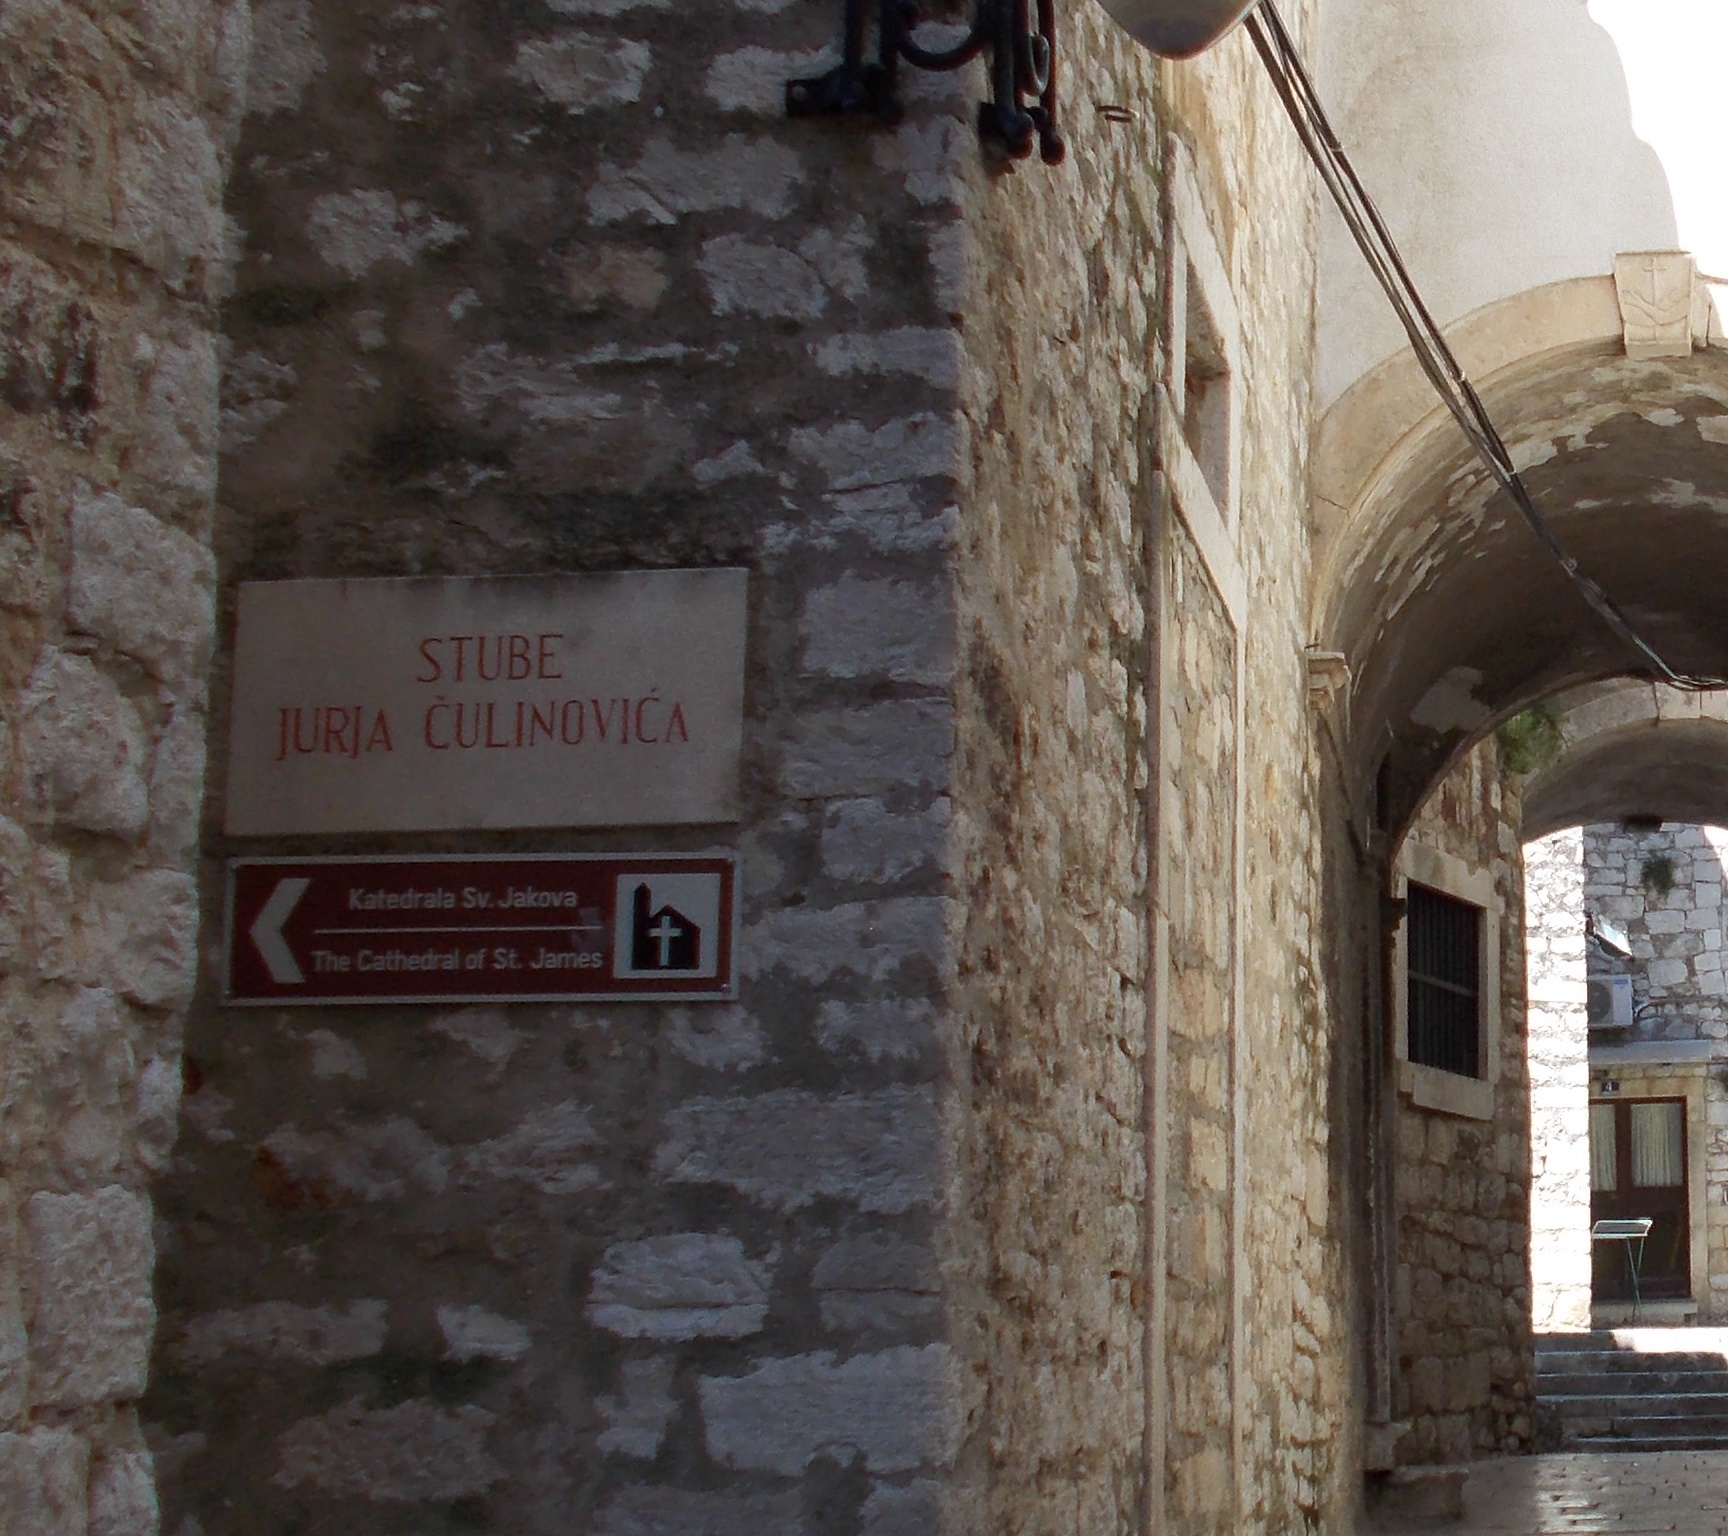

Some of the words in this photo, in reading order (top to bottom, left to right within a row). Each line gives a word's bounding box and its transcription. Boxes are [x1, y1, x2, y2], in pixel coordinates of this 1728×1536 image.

[416, 633, 565, 683] STUBE
[275, 705, 394, 762] JURJA
[423, 687, 690, 751] ČULINOVIĆA
[348, 887, 456, 911] Katedrala
[462, 887, 493, 909] Sv.
[498, 886, 578, 909] Jakova
[311, 949, 351, 972] The
[357, 947, 460, 971] Cathedral
[466, 948, 486, 970] of
[491, 947, 523, 969] St.
[530, 947, 604, 969] James
